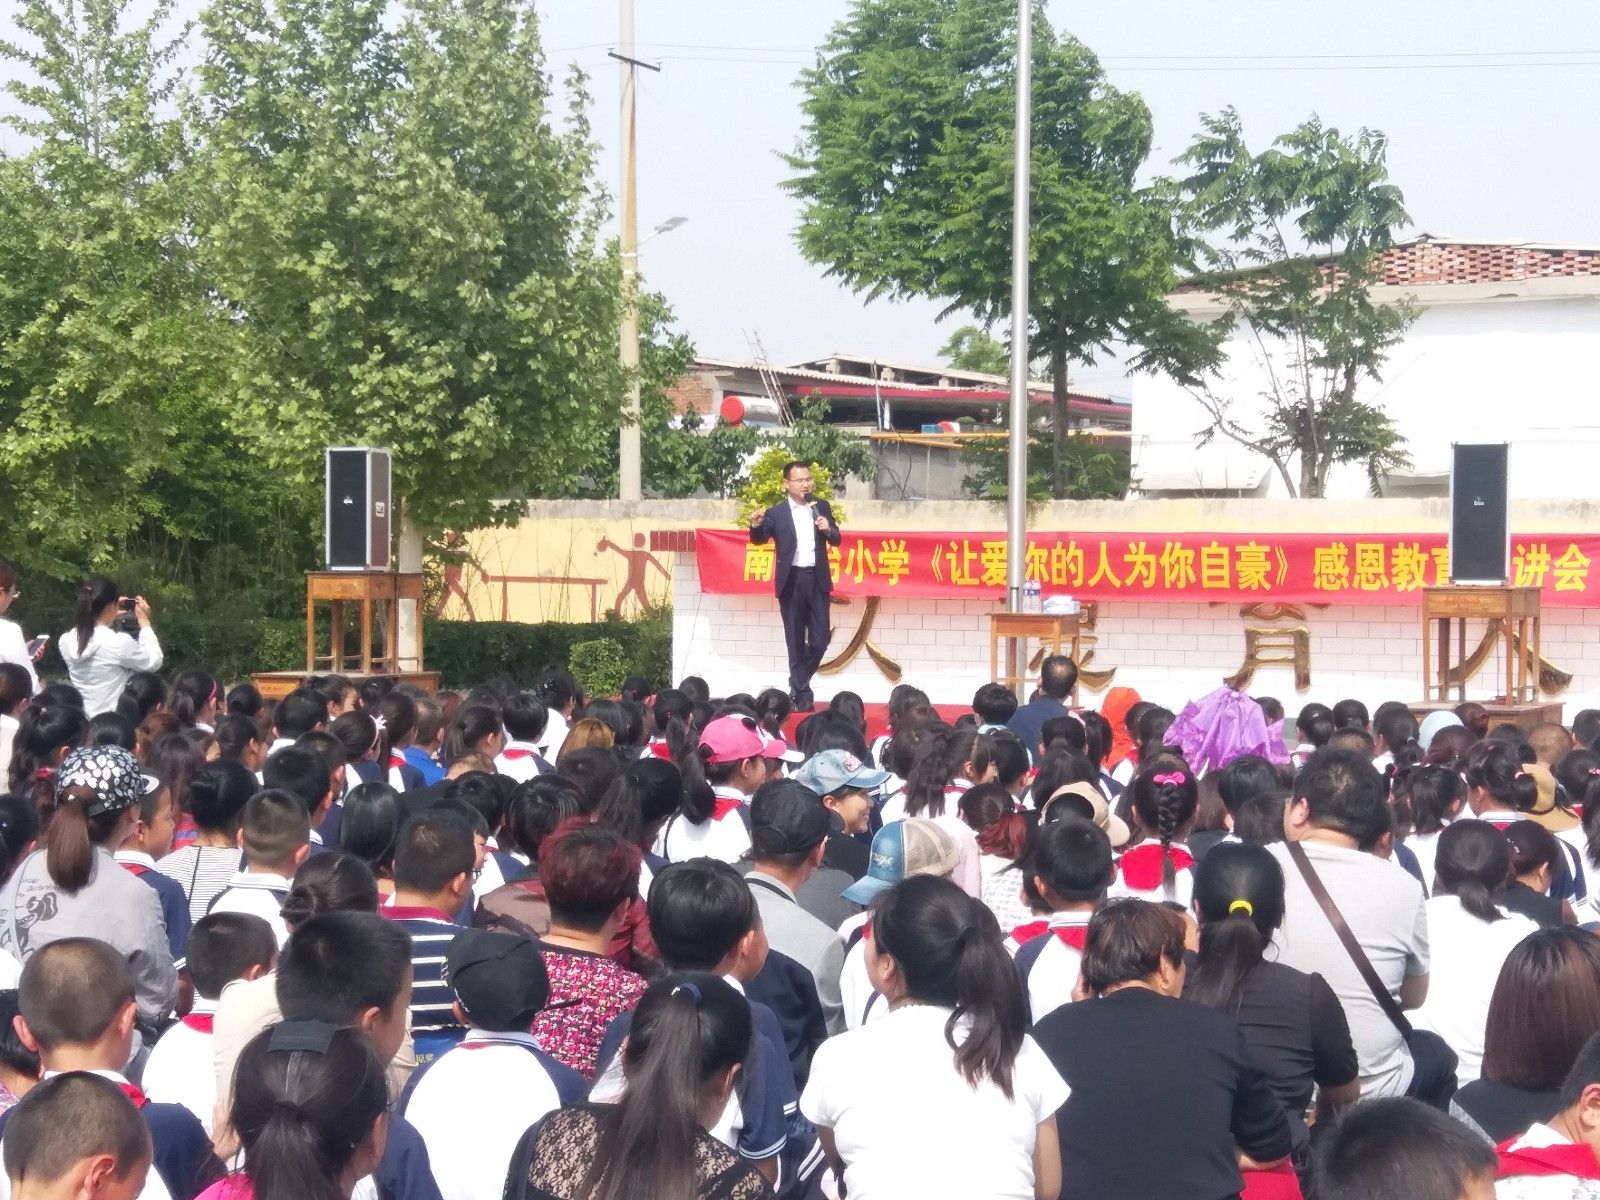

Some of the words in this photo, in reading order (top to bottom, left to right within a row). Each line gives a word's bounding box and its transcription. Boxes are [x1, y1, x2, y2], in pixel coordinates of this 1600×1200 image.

[743, 539, 1591, 592] 南小学《让爱你的人为你自豪》感恩教讲会
